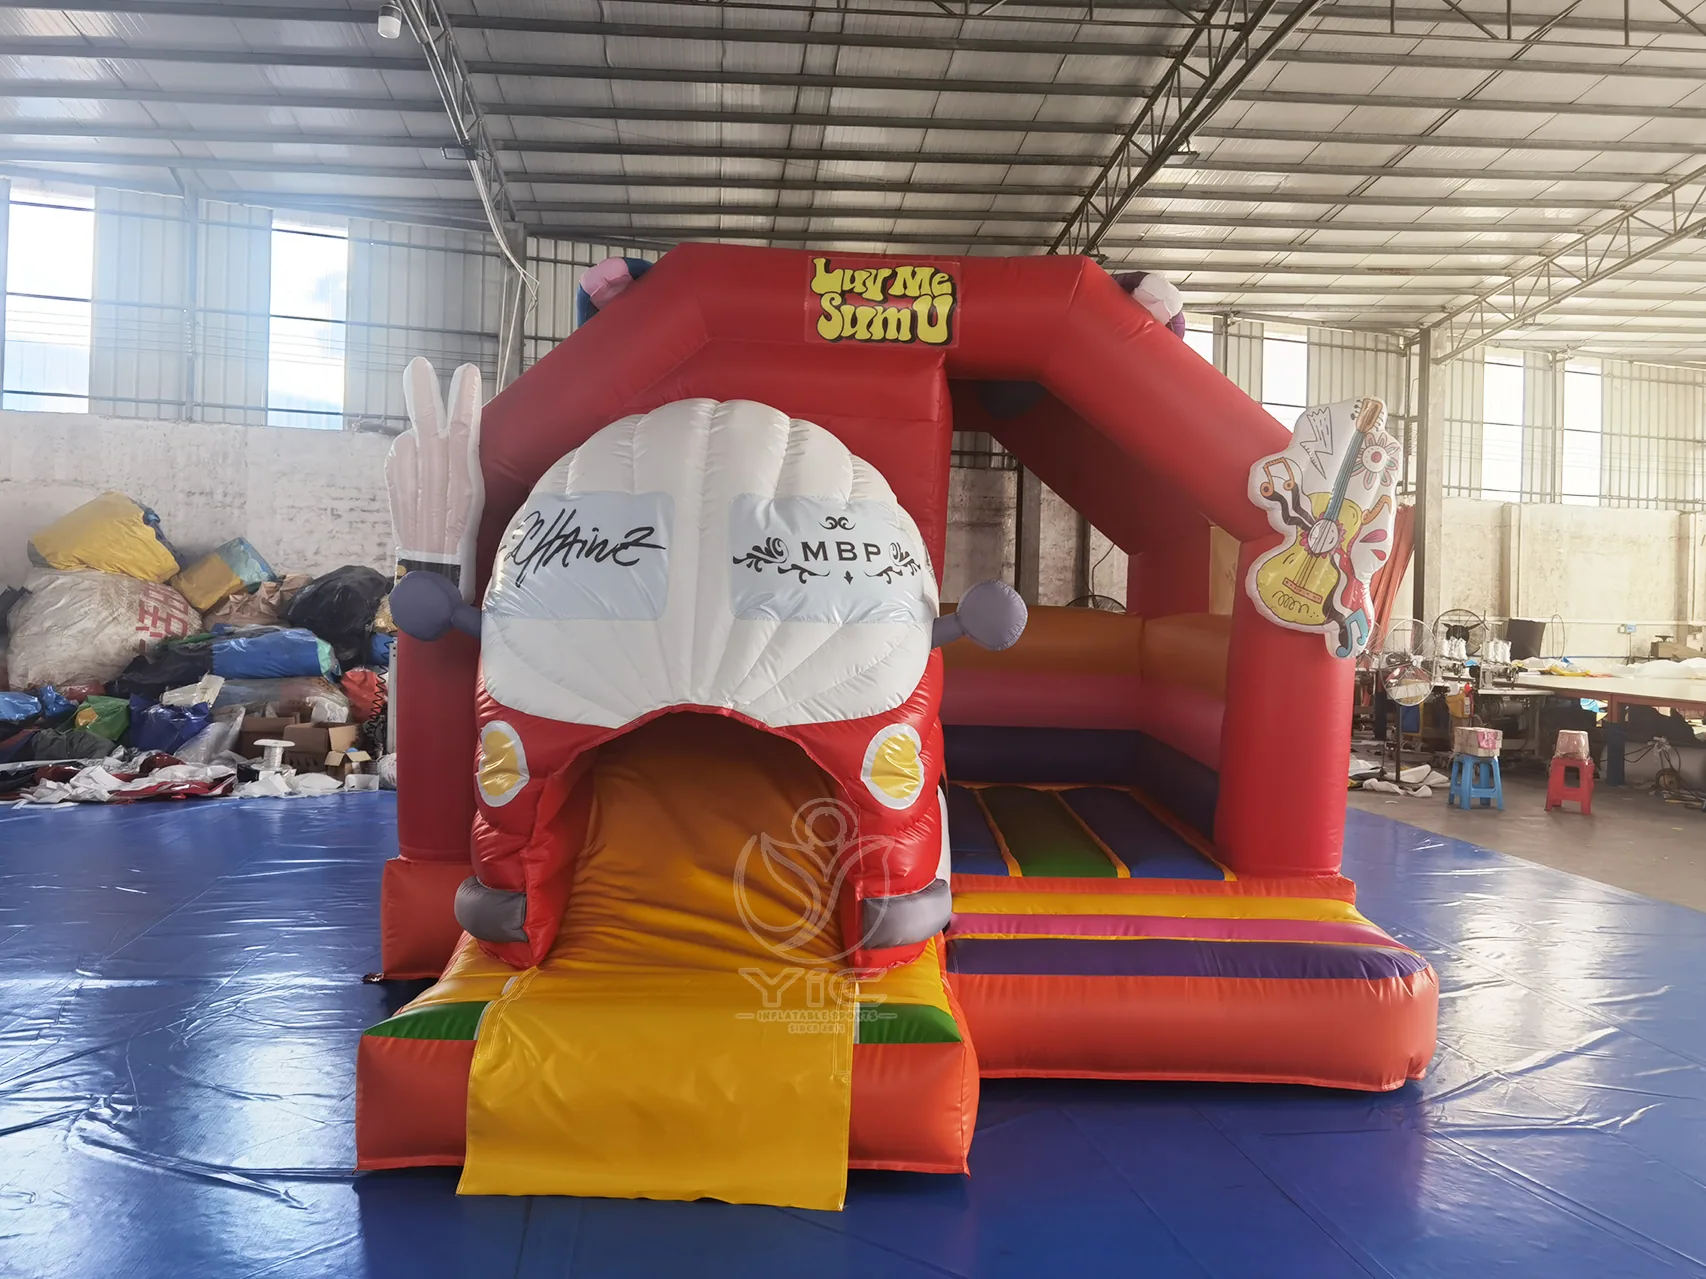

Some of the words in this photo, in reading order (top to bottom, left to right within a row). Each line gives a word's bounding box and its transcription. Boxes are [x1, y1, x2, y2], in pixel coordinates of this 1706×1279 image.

[810, 257, 893, 302] Luv
[887, 265, 957, 298] Me
[816, 291, 917, 342] Sum
[912, 293, 955, 345] U
[800, 541, 881, 563] MBP
